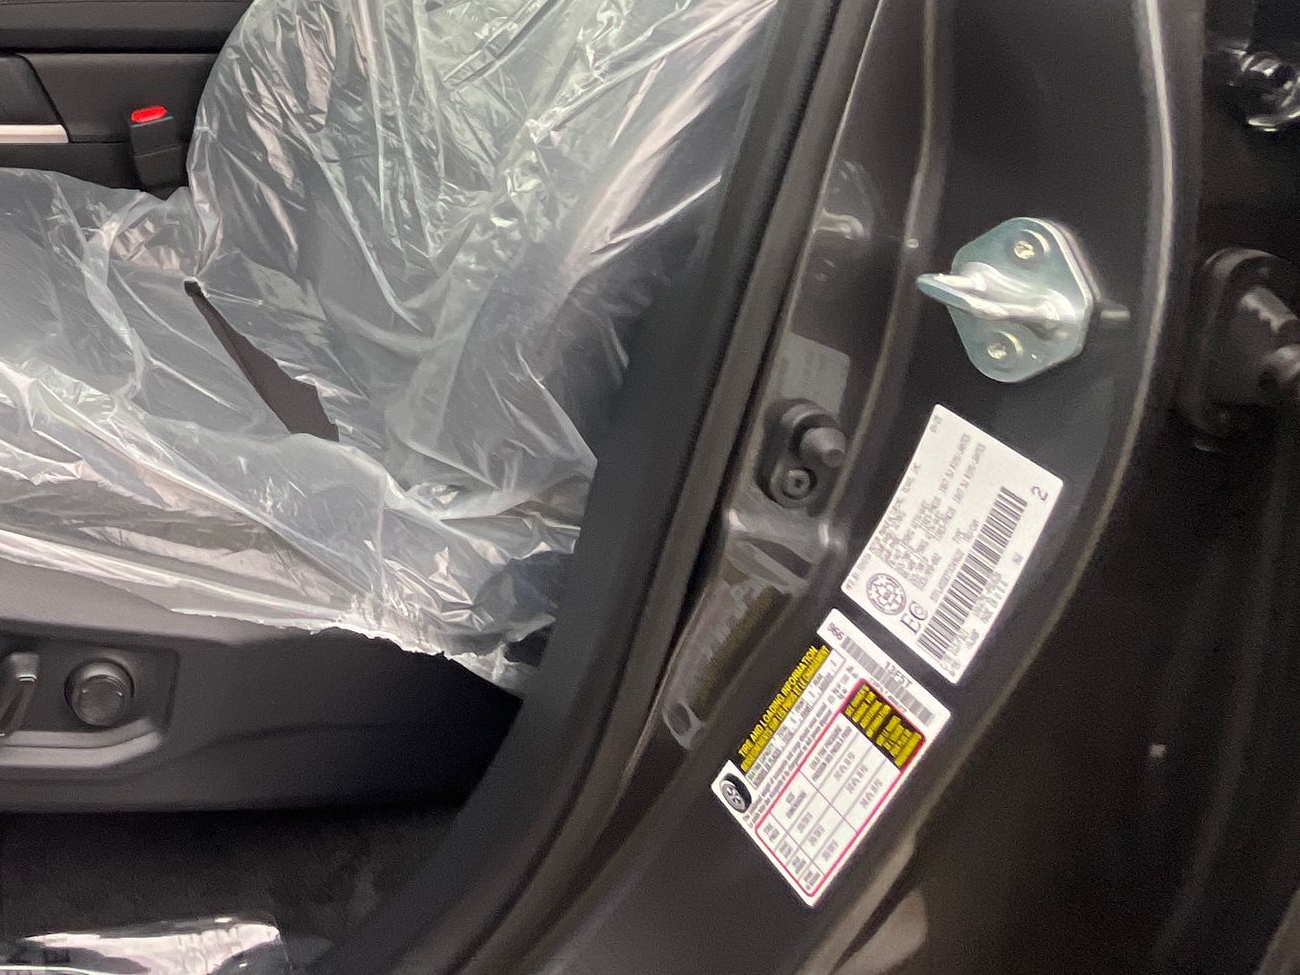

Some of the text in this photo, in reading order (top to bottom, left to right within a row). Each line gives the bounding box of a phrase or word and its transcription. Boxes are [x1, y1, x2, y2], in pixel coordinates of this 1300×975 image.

[738, 645, 818, 758] TIRE AND LOADING INFORMATION
